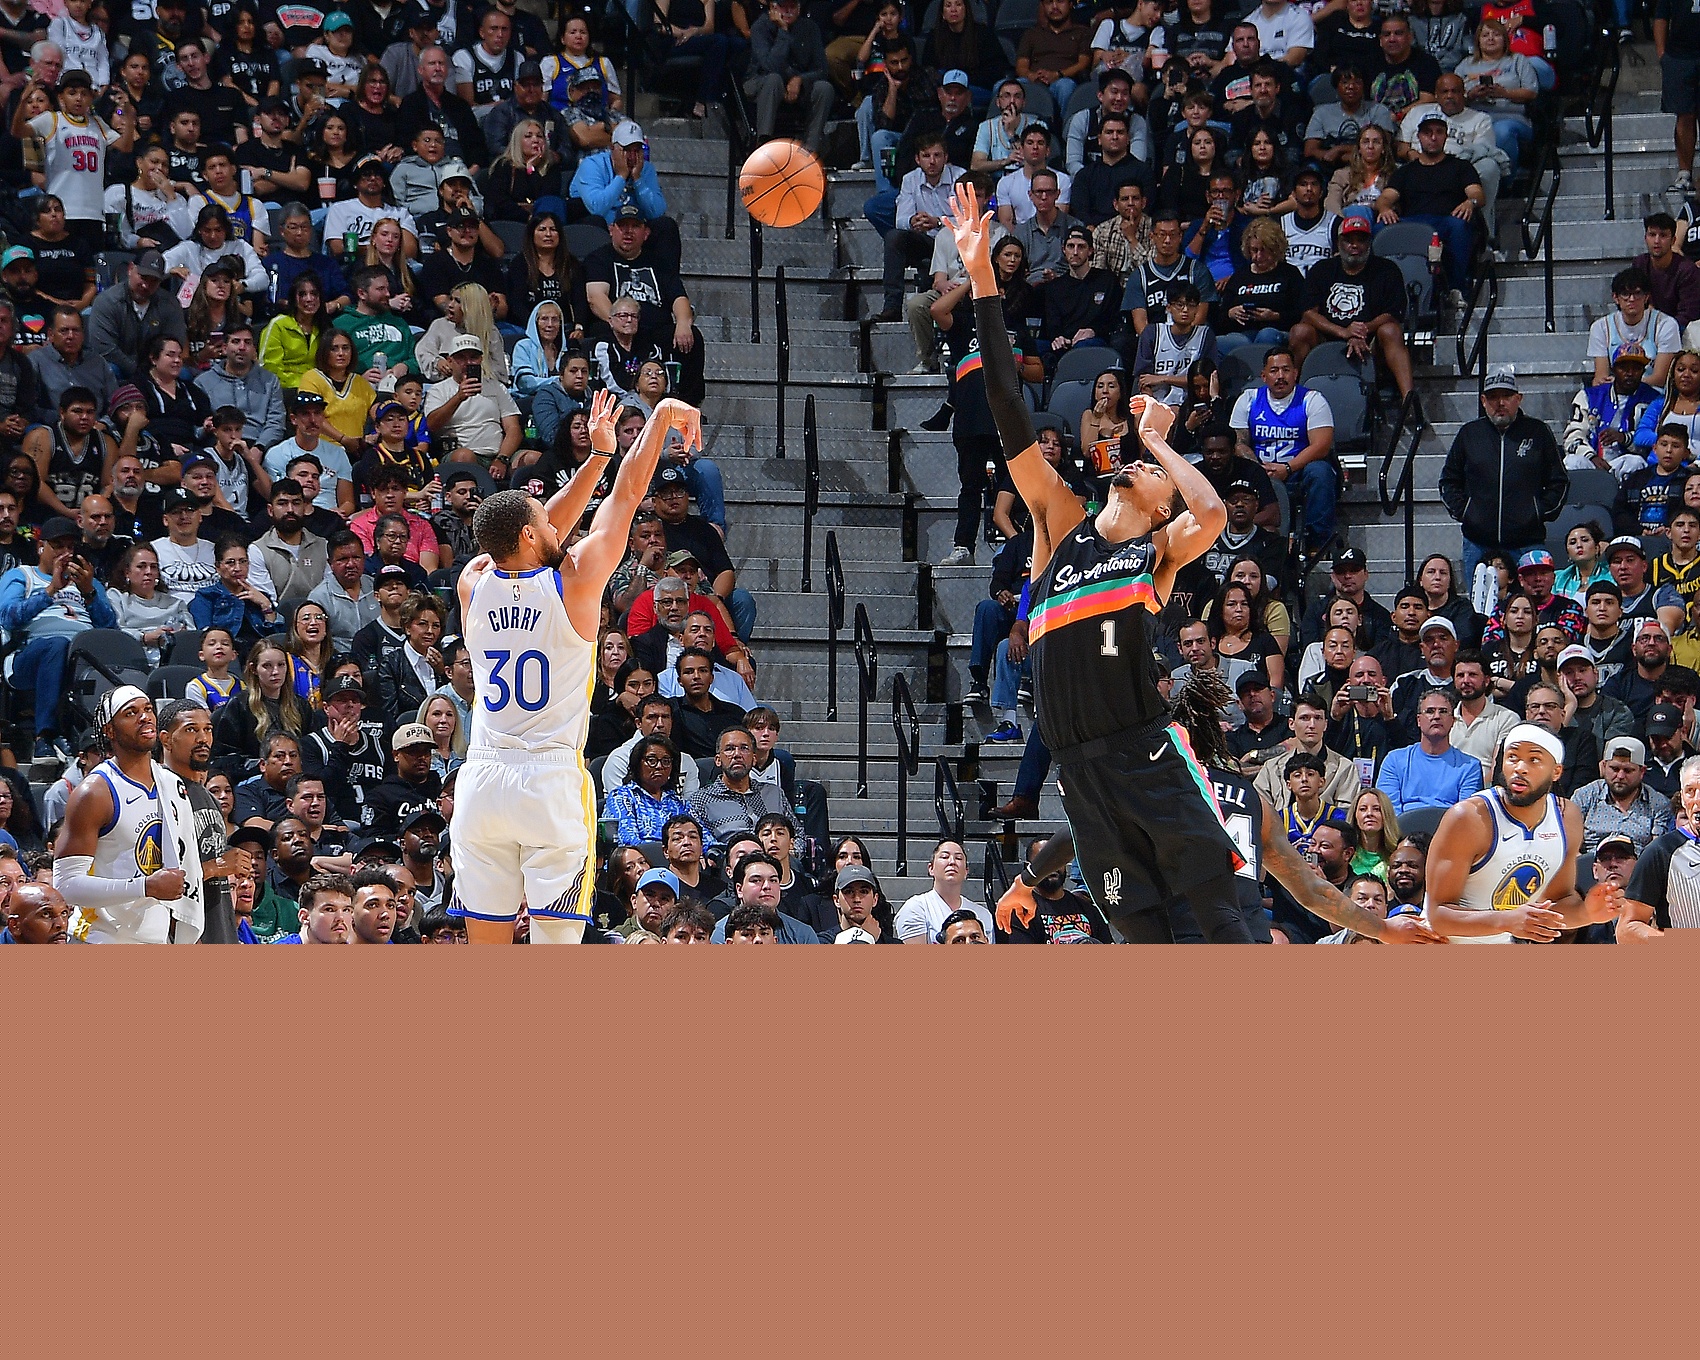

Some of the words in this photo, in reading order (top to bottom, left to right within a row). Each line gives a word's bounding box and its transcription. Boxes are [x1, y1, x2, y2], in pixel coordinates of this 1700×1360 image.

[73, 150, 99, 172] 30
[1255, 425, 1299, 440] FRANCE
[1259, 439, 1296, 463] 32
[1054, 564, 1083, 592] San
[1083, 555, 1145, 582] Antonio
[487, 606, 543, 633] CURRY
[1100, 619, 1119, 657] 1
[482, 648, 551, 713] 30
[1213, 780, 1248, 809] ELL
[135, 810, 159, 835] GOLDEN
[1225, 812, 1259, 881] 4
[1501, 854, 1532, 876] GOLDEN
[1533, 854, 1551, 873] STATE
[1525, 876, 1537, 894] 4
